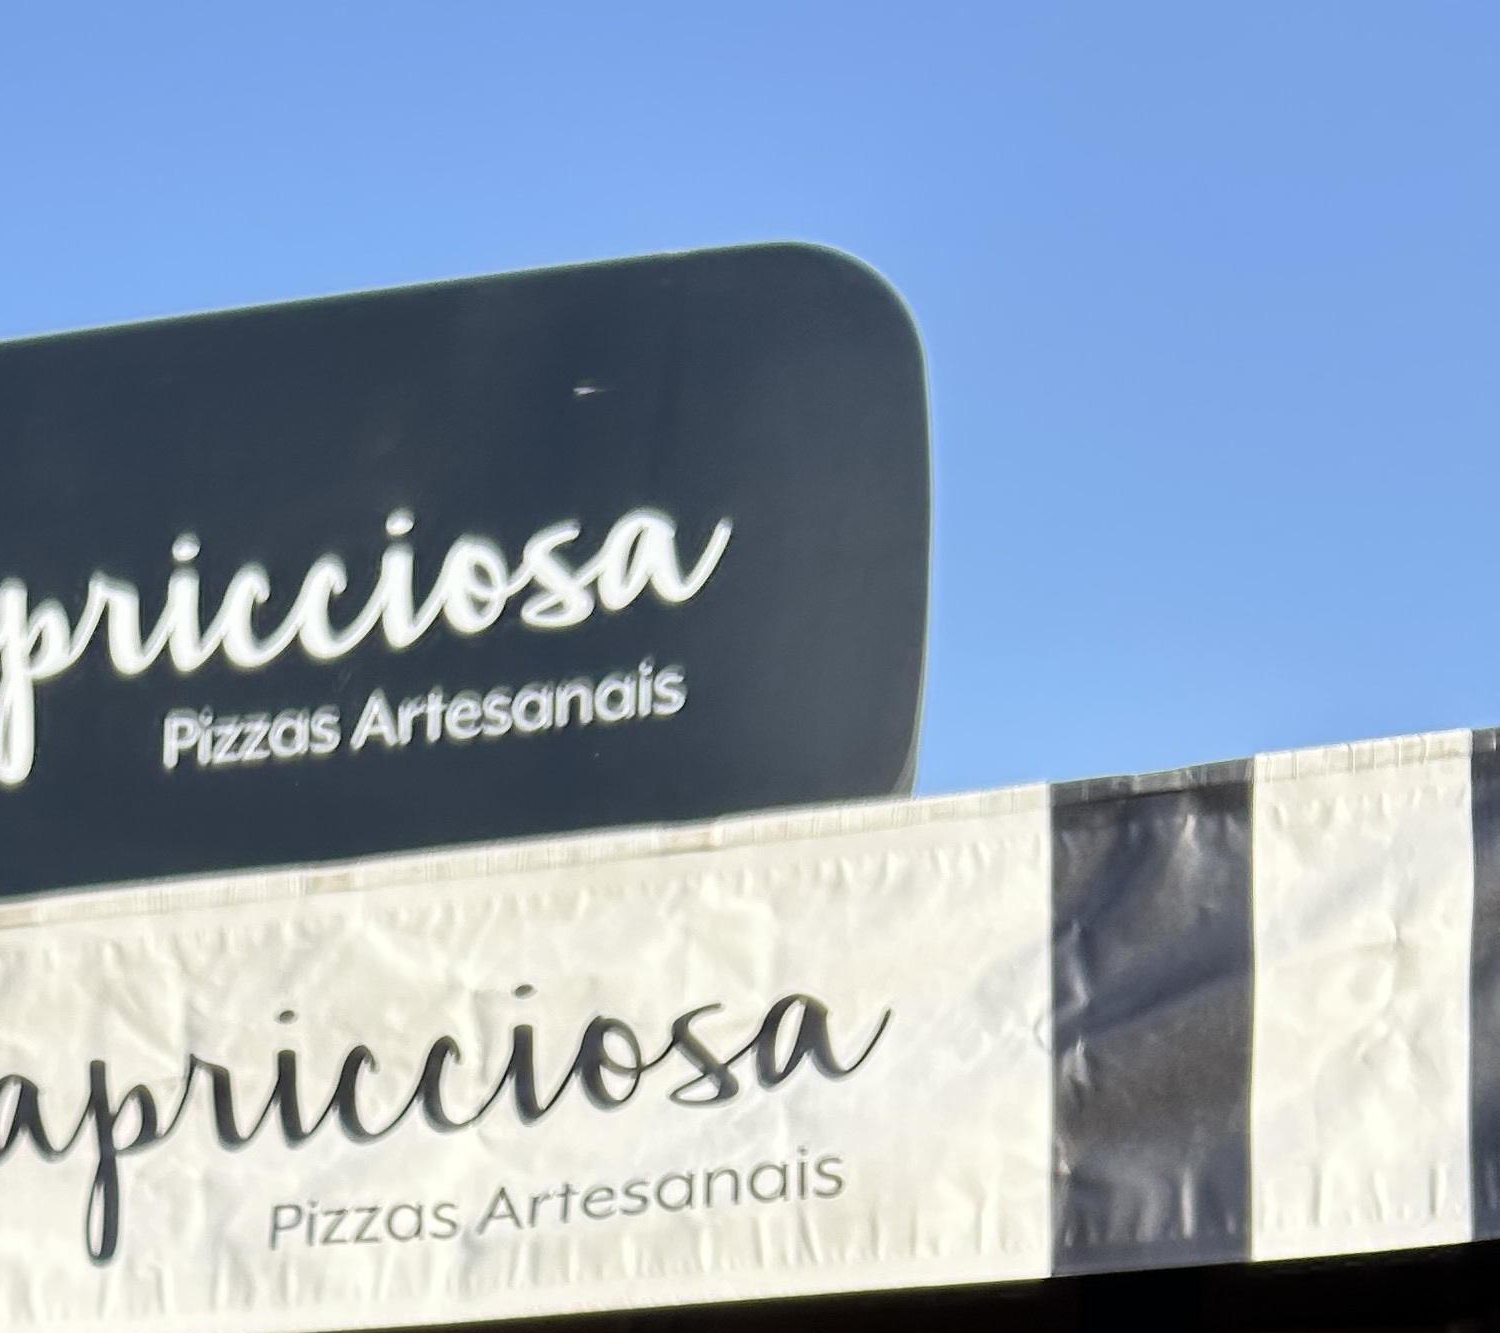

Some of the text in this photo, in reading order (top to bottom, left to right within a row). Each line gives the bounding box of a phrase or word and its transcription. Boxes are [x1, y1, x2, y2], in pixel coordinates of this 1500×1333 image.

[162, 656, 688, 770] Pizzas Artesanais
[268, 1145, 846, 1250] Pizzas Artesanais
